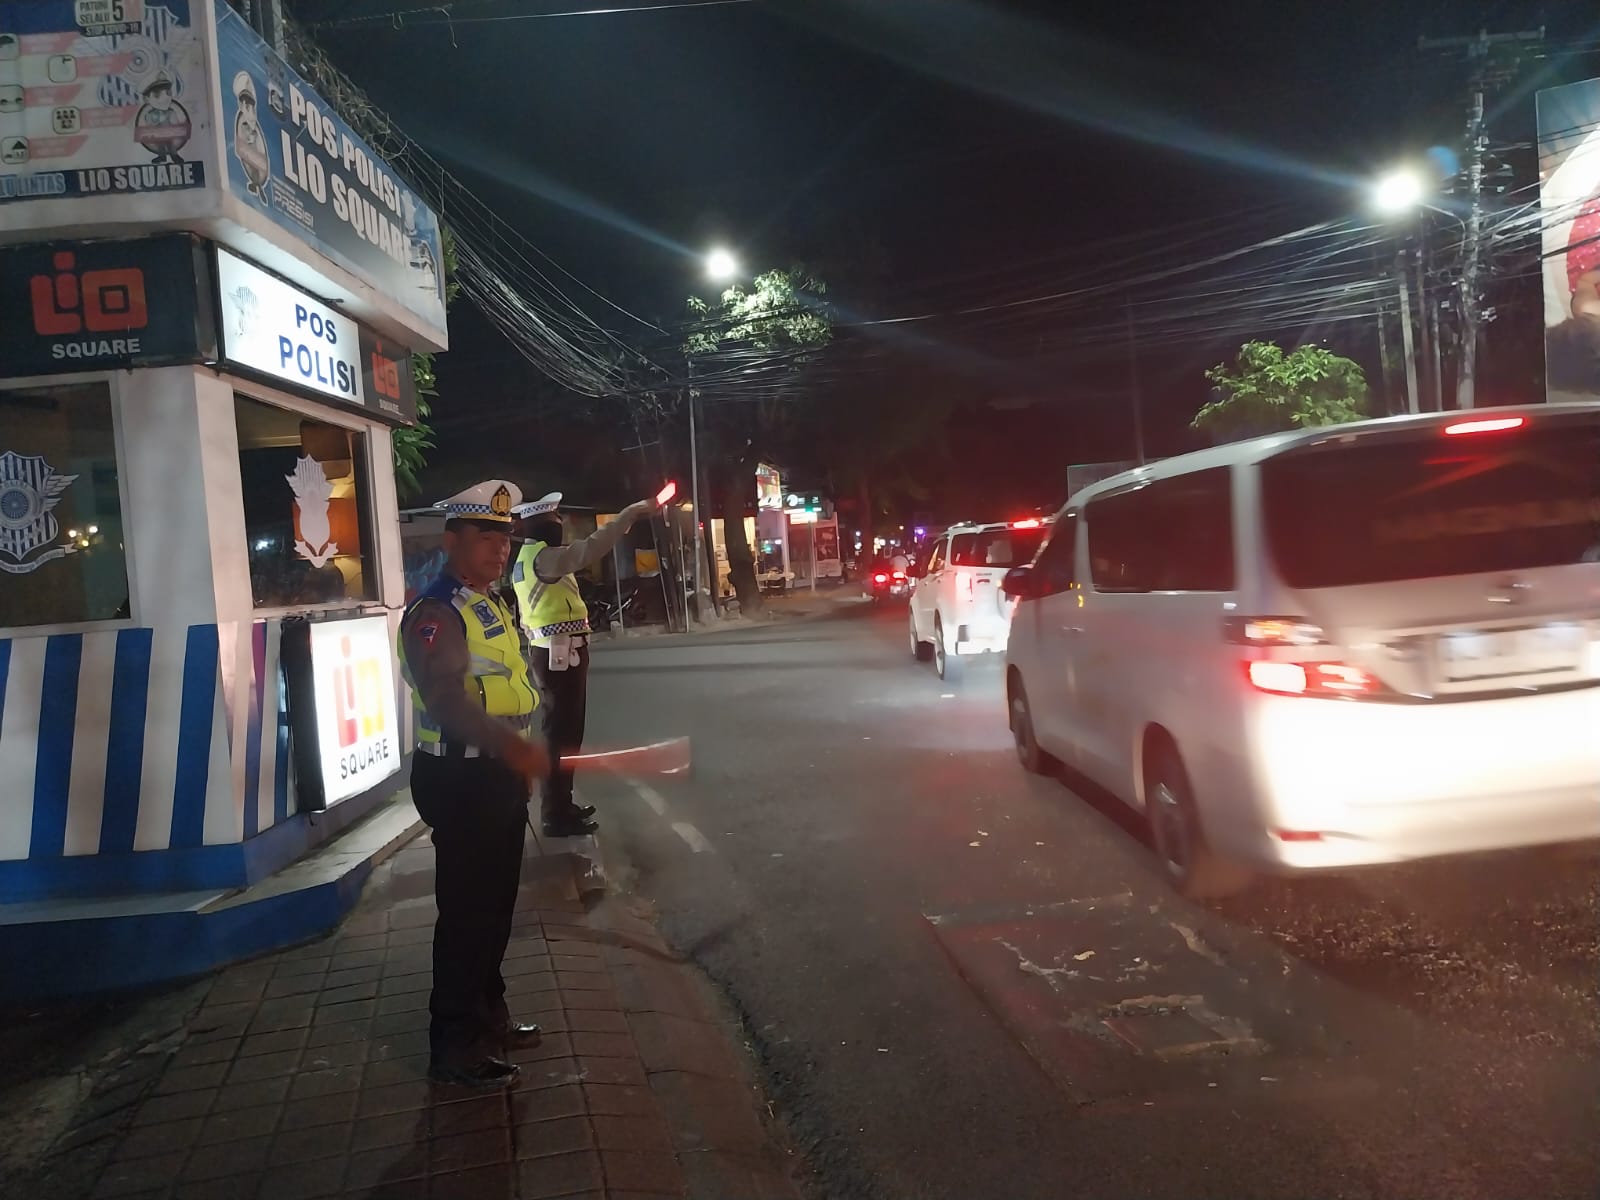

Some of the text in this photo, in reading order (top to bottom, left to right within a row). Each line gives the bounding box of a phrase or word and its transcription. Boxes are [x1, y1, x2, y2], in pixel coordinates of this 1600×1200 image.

[112, 0, 124, 21] 5
[281, 129, 327, 204] LIO
[289, 82, 339, 160] POS
[341, 133, 402, 218] POLISI
[79, 163, 195, 193] LIO SQUARE
[295, 303, 337, 345] POS
[51, 338, 141, 360] SQUARE
[278, 334, 357, 396] POLISI
[340, 737, 390, 780] SQUARE
